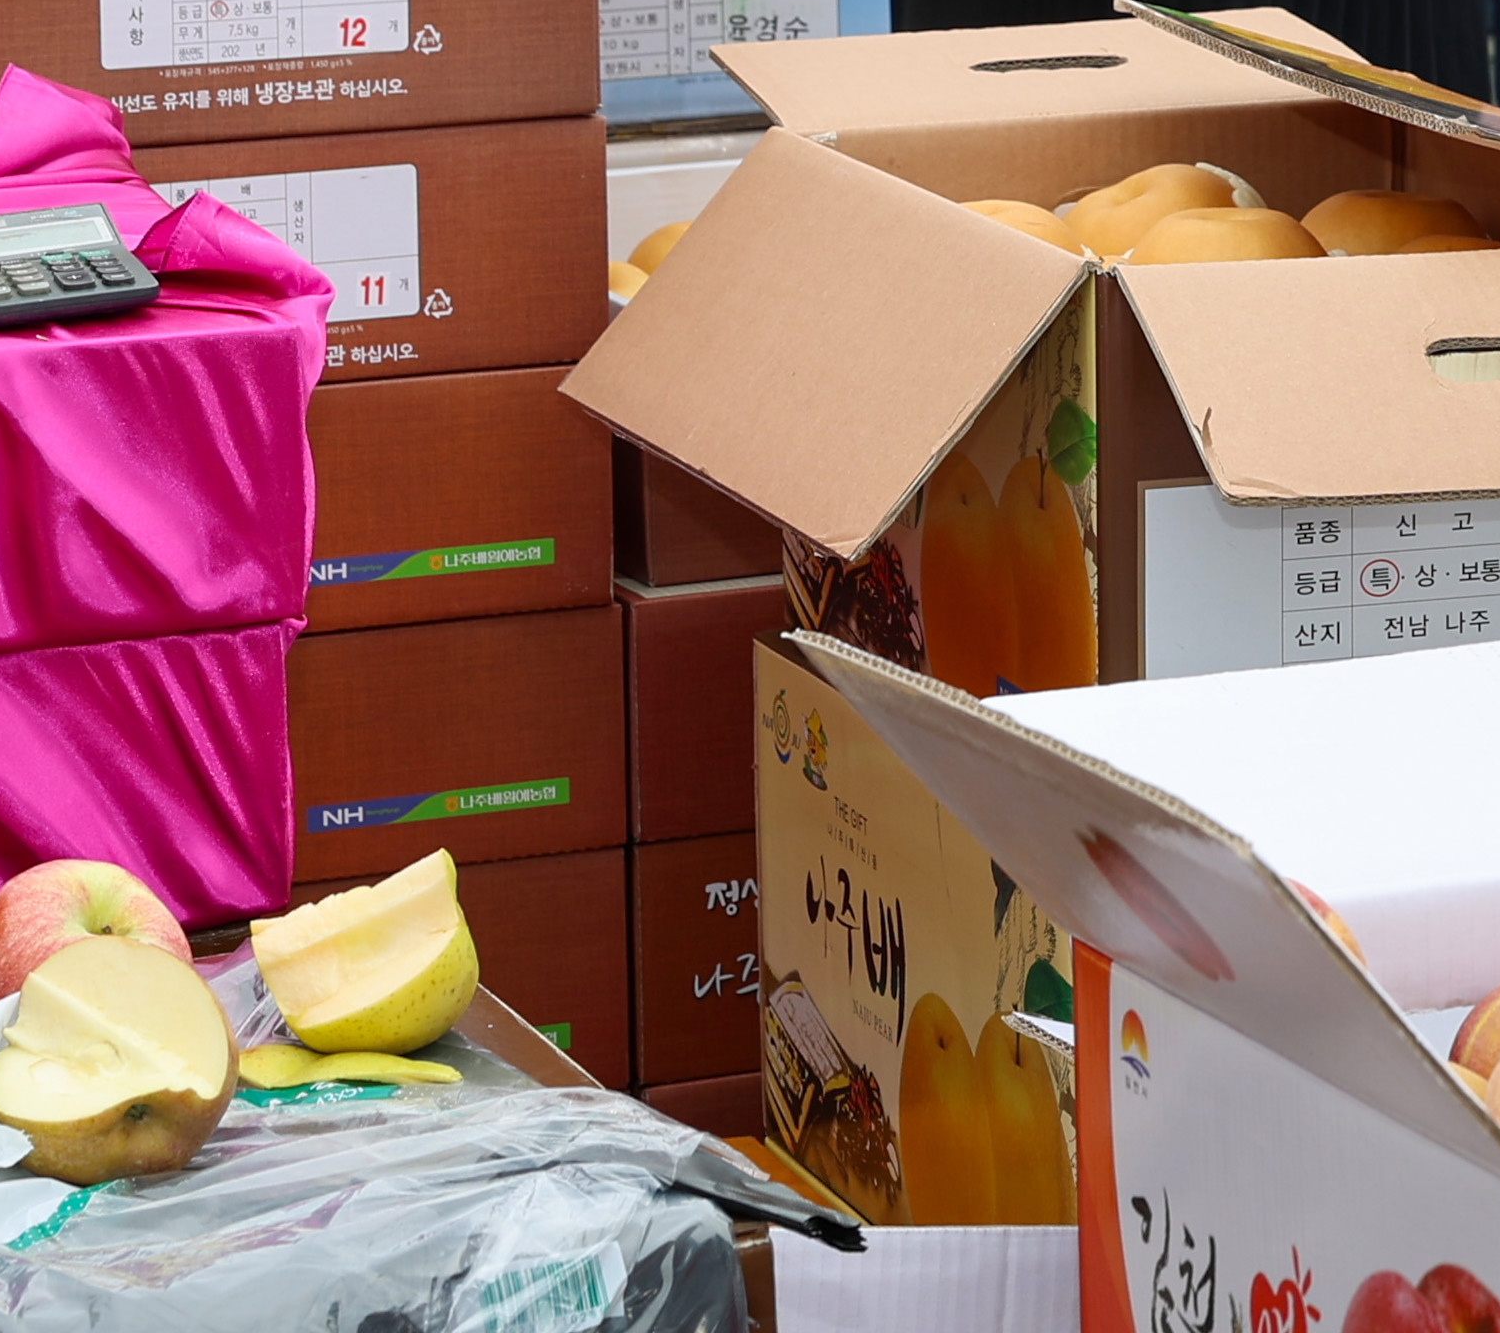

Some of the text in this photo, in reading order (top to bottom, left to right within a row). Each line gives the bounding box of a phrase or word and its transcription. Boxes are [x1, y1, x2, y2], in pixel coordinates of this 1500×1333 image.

[338, 17, 368, 48] 12
[388, 19, 399, 33] 개
[220, 44, 241, 59] 202
[161, 90, 212, 110] 유지를
[215, 86, 249, 107] 위해
[253, 77, 336, 106] 냉장보관
[338, 77, 409, 99] 하십시오.
[360, 275, 386, 306] 11
[398, 278, 409, 291] 개
[349, 342, 419, 366] 하십시오.
[1293, 519, 1342, 547] 품종
[308, 561, 348, 583] NH
[1293, 568, 1342, 597] 등급
[1294, 620, 1343, 647] 산지
[1383, 608, 1491, 640] 전남 나주
[322, 805, 364, 828] NH
[834, 795, 869, 837] THE GIFT
